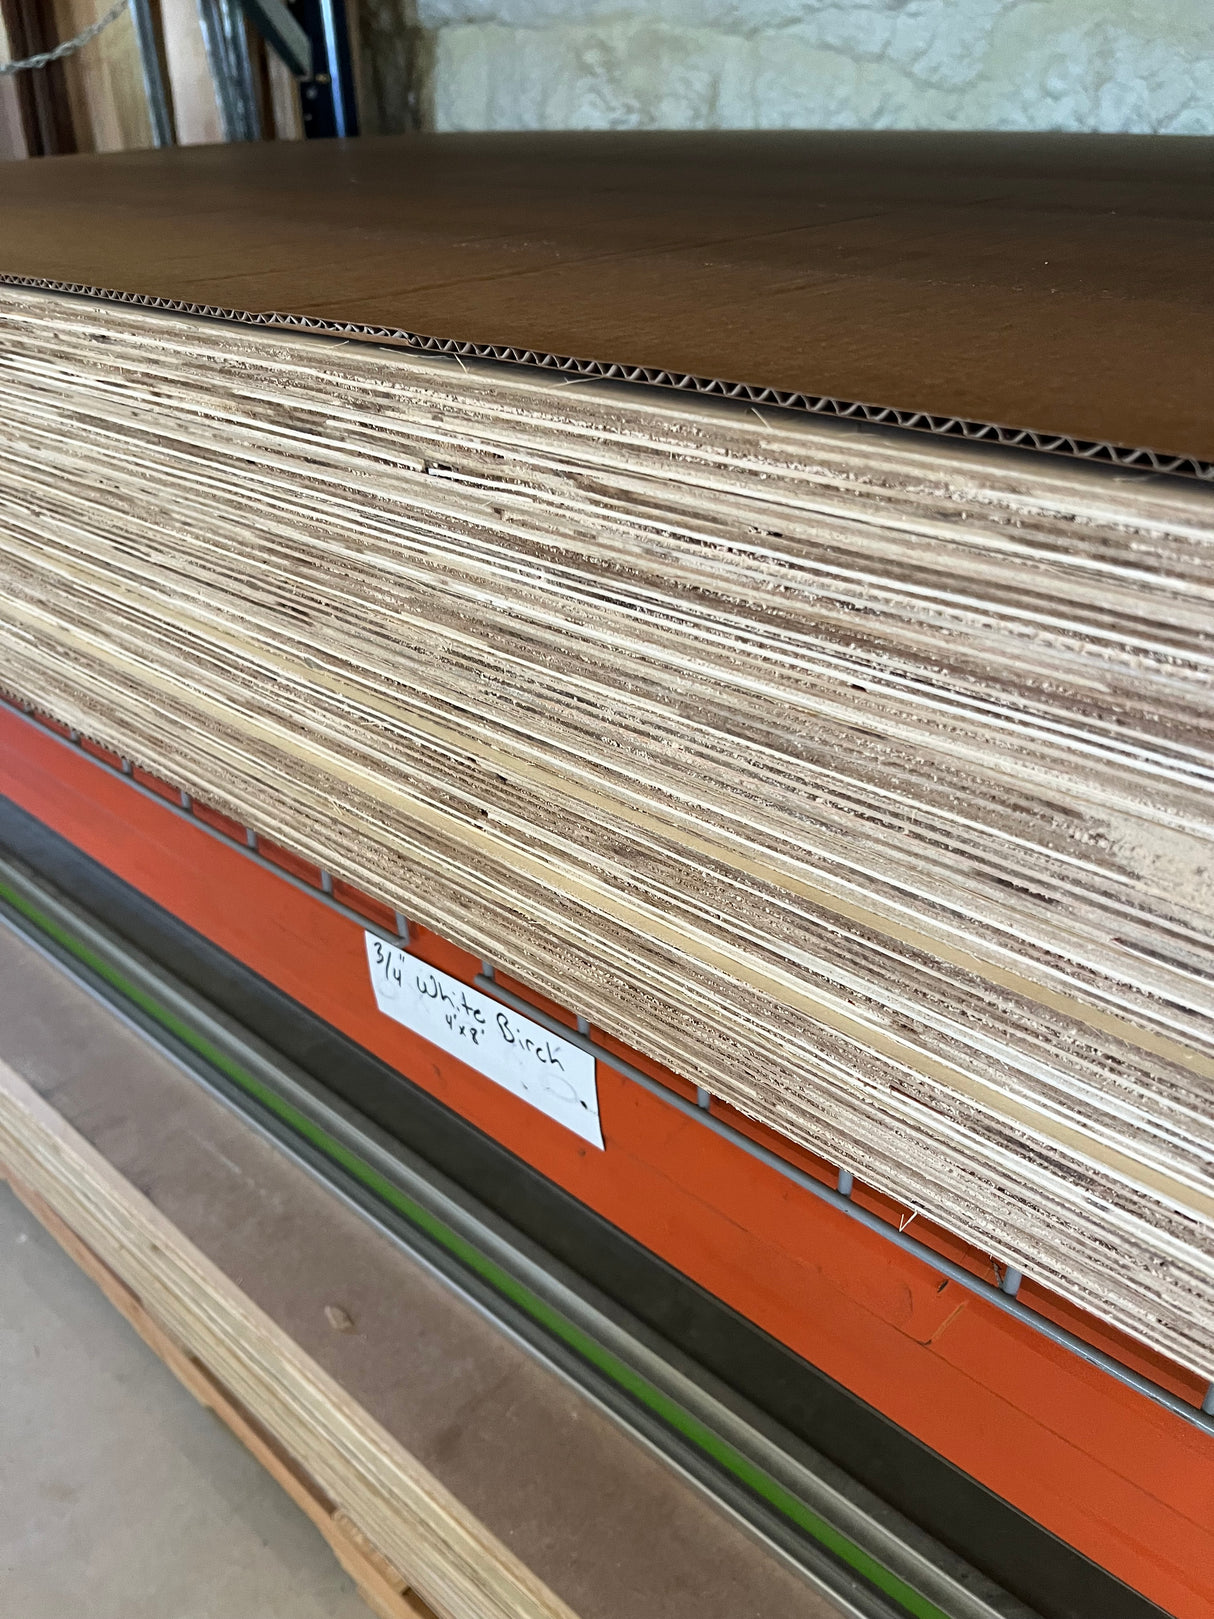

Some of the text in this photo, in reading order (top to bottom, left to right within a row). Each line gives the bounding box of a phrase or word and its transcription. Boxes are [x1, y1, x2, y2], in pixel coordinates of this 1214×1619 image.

[373, 941, 565, 1072] 3/4" White Birch
